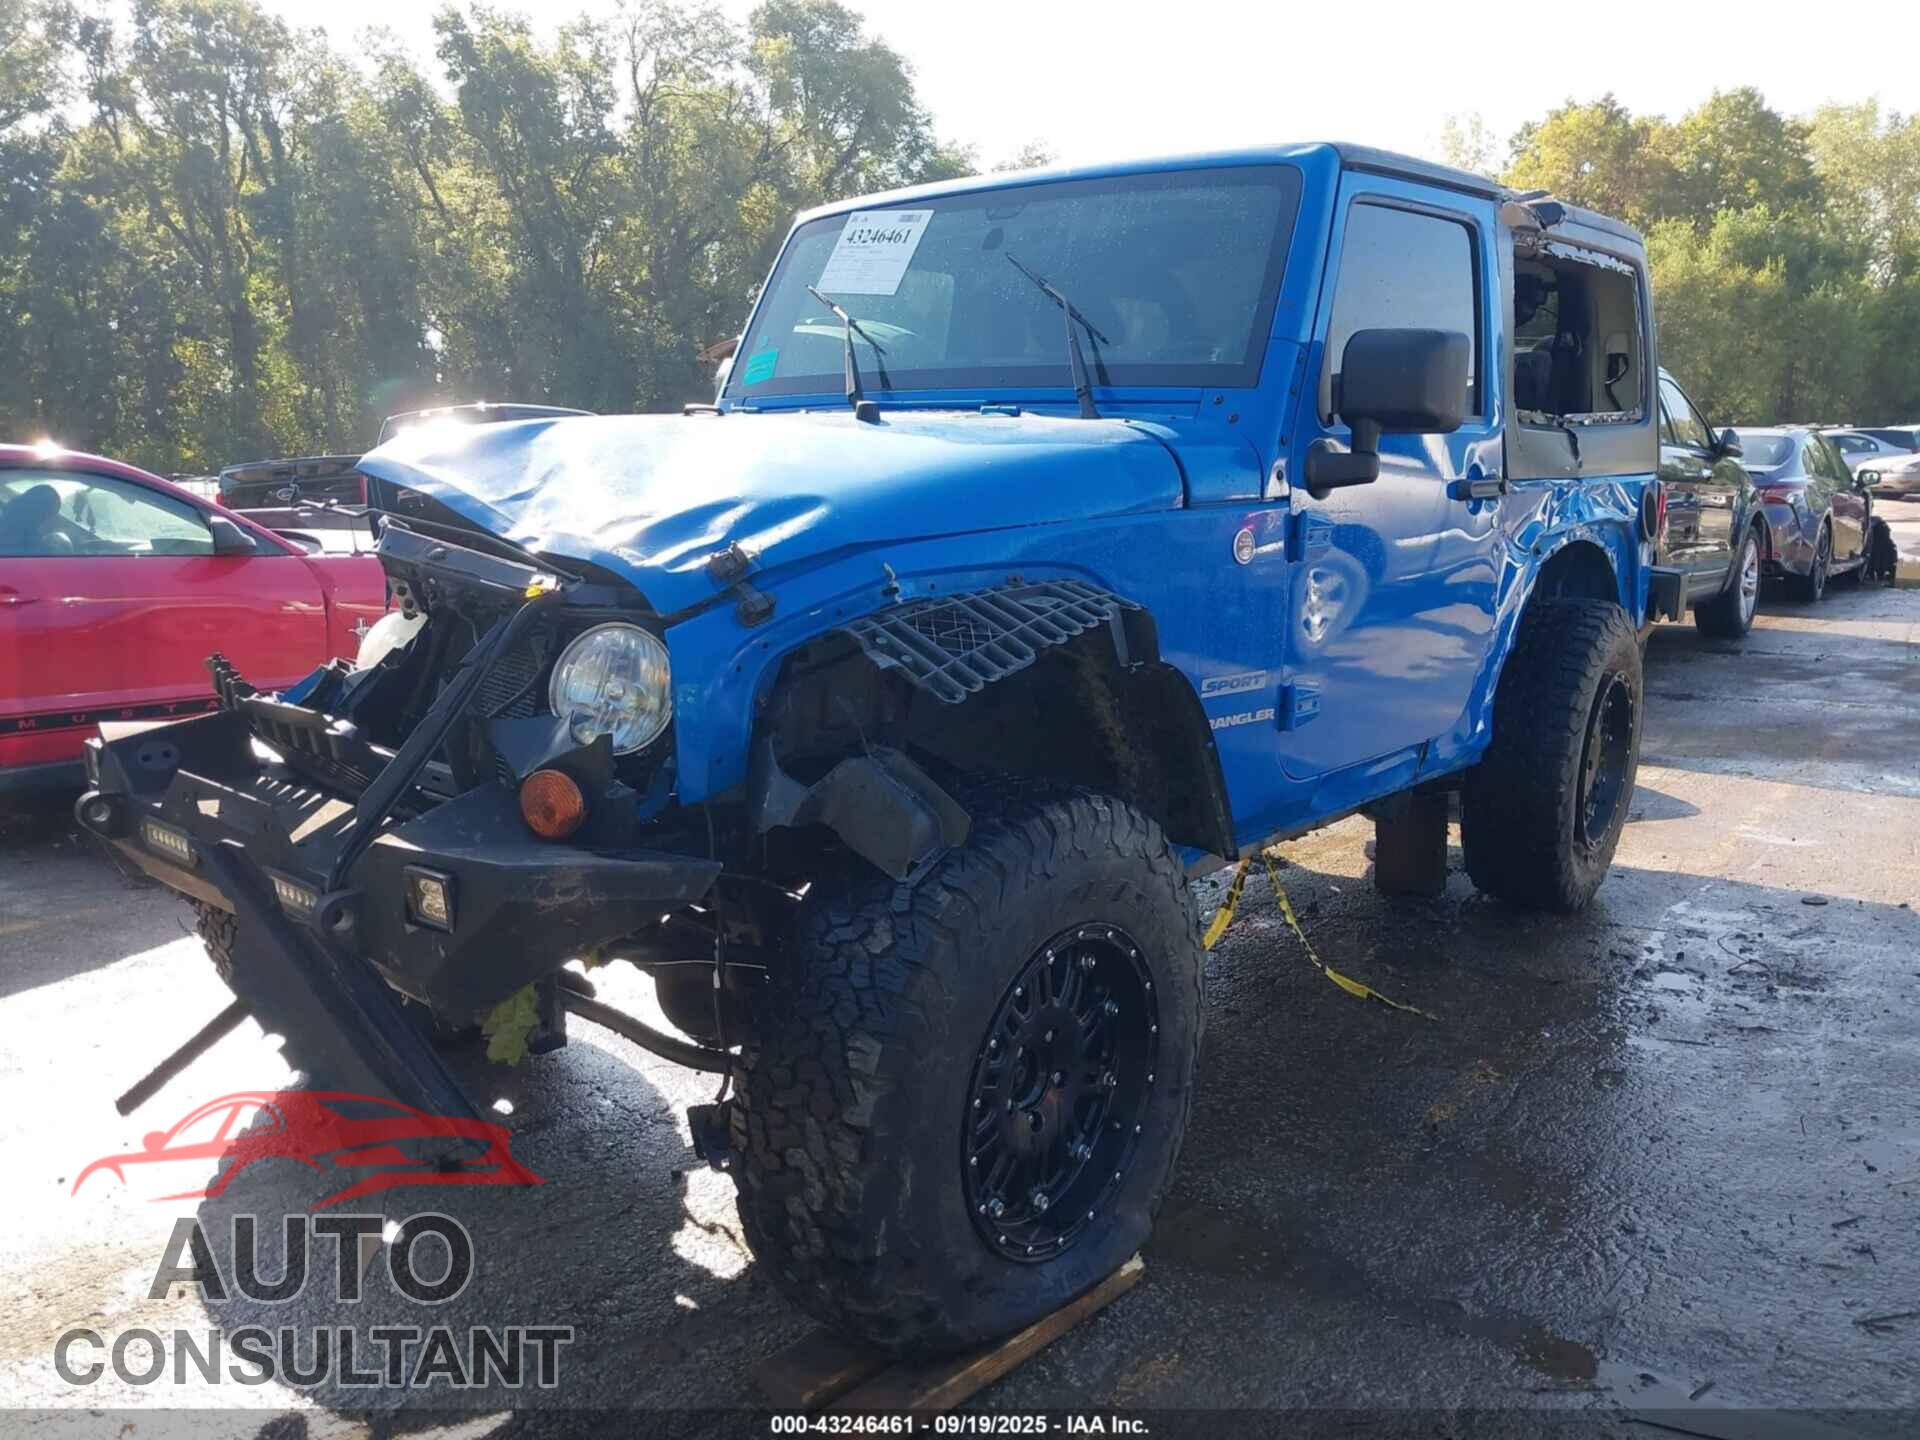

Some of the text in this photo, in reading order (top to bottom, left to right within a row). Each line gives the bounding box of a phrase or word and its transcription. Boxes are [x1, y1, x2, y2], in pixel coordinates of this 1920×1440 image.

[846, 228, 912, 245] 43246461
[1202, 674, 1265, 693] SPORT
[17, 699, 219, 730] MUSTA
[1208, 708, 1275, 729] RANGLER
